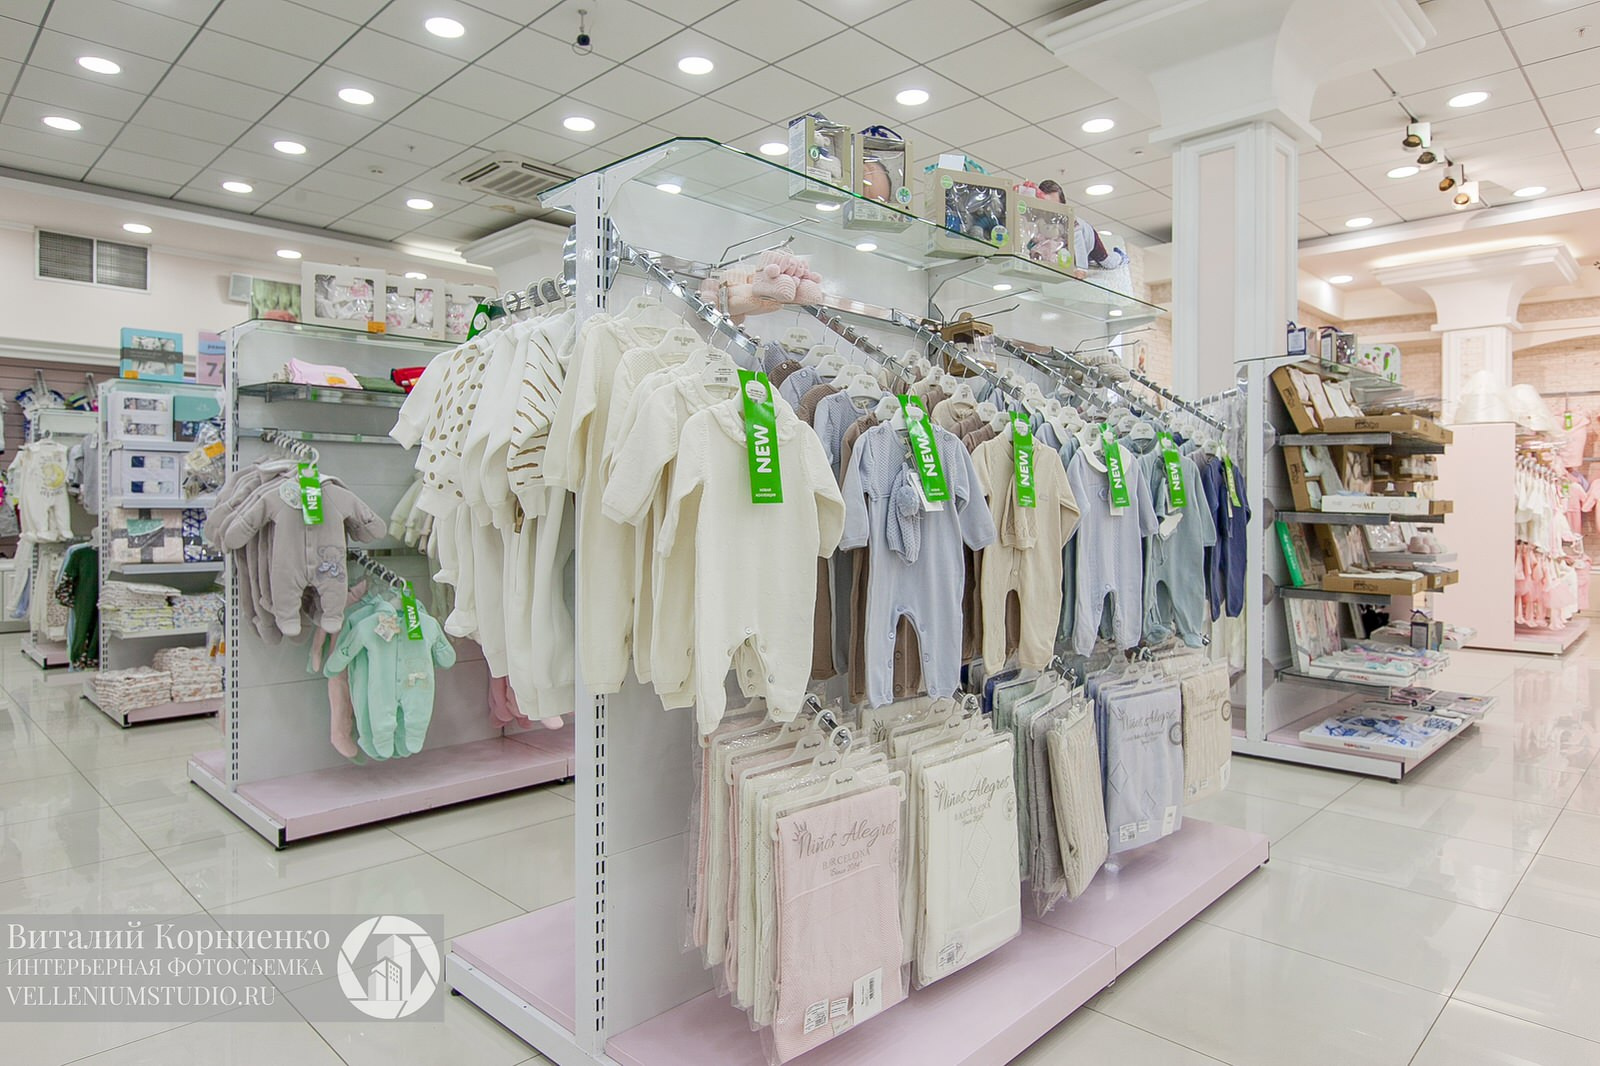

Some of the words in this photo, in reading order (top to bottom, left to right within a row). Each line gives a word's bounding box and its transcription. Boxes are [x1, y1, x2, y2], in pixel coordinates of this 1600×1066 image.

[752, 424, 772, 474] NEW
[916, 433, 938, 477] NEW
[1018, 450, 1031, 487] NEW
[1109, 457, 1123, 489] NEW
[1169, 462, 1181, 491] NEW
[306, 486, 318, 510] NEW
[407, 605, 417, 628] NEW
